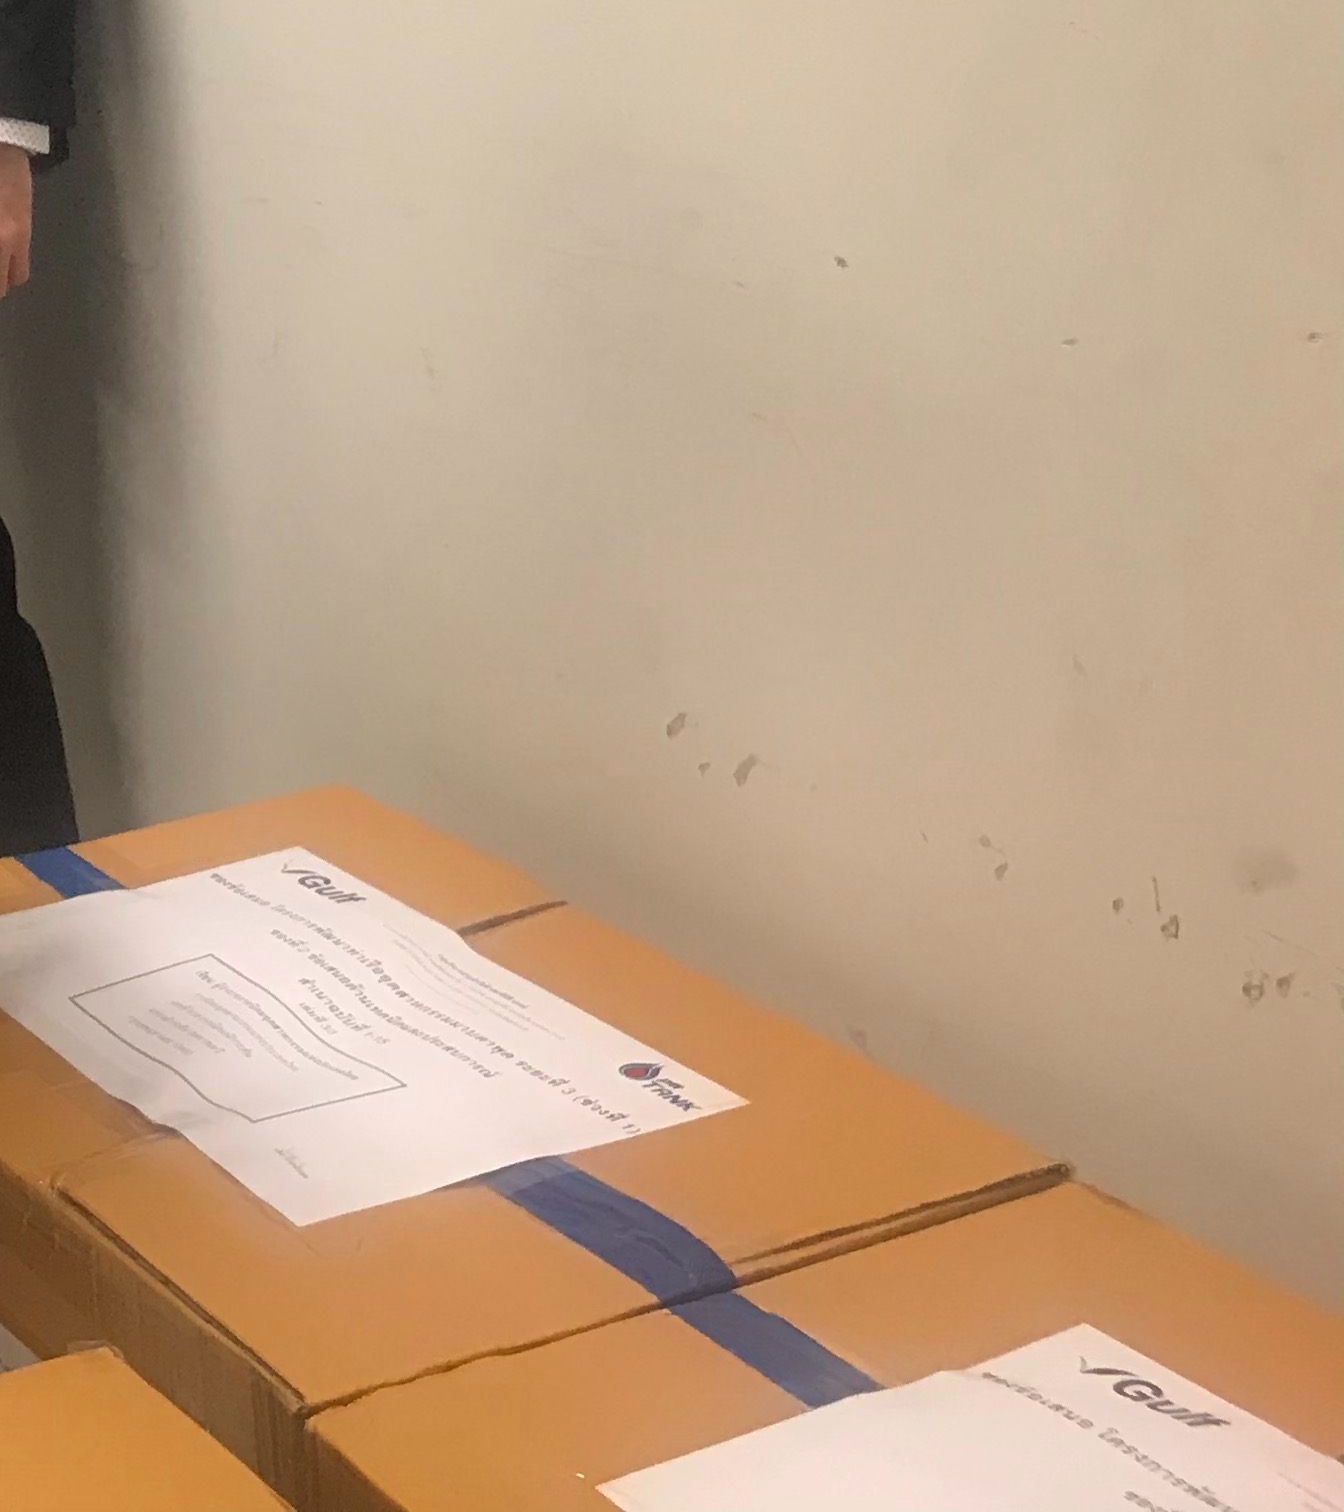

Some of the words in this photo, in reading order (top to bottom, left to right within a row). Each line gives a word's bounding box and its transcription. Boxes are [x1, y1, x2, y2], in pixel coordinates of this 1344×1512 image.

[297, 874, 368, 905] Gulf
[641, 1080, 702, 1113] TANK
[1112, 1378, 1232, 1428] Gulf
